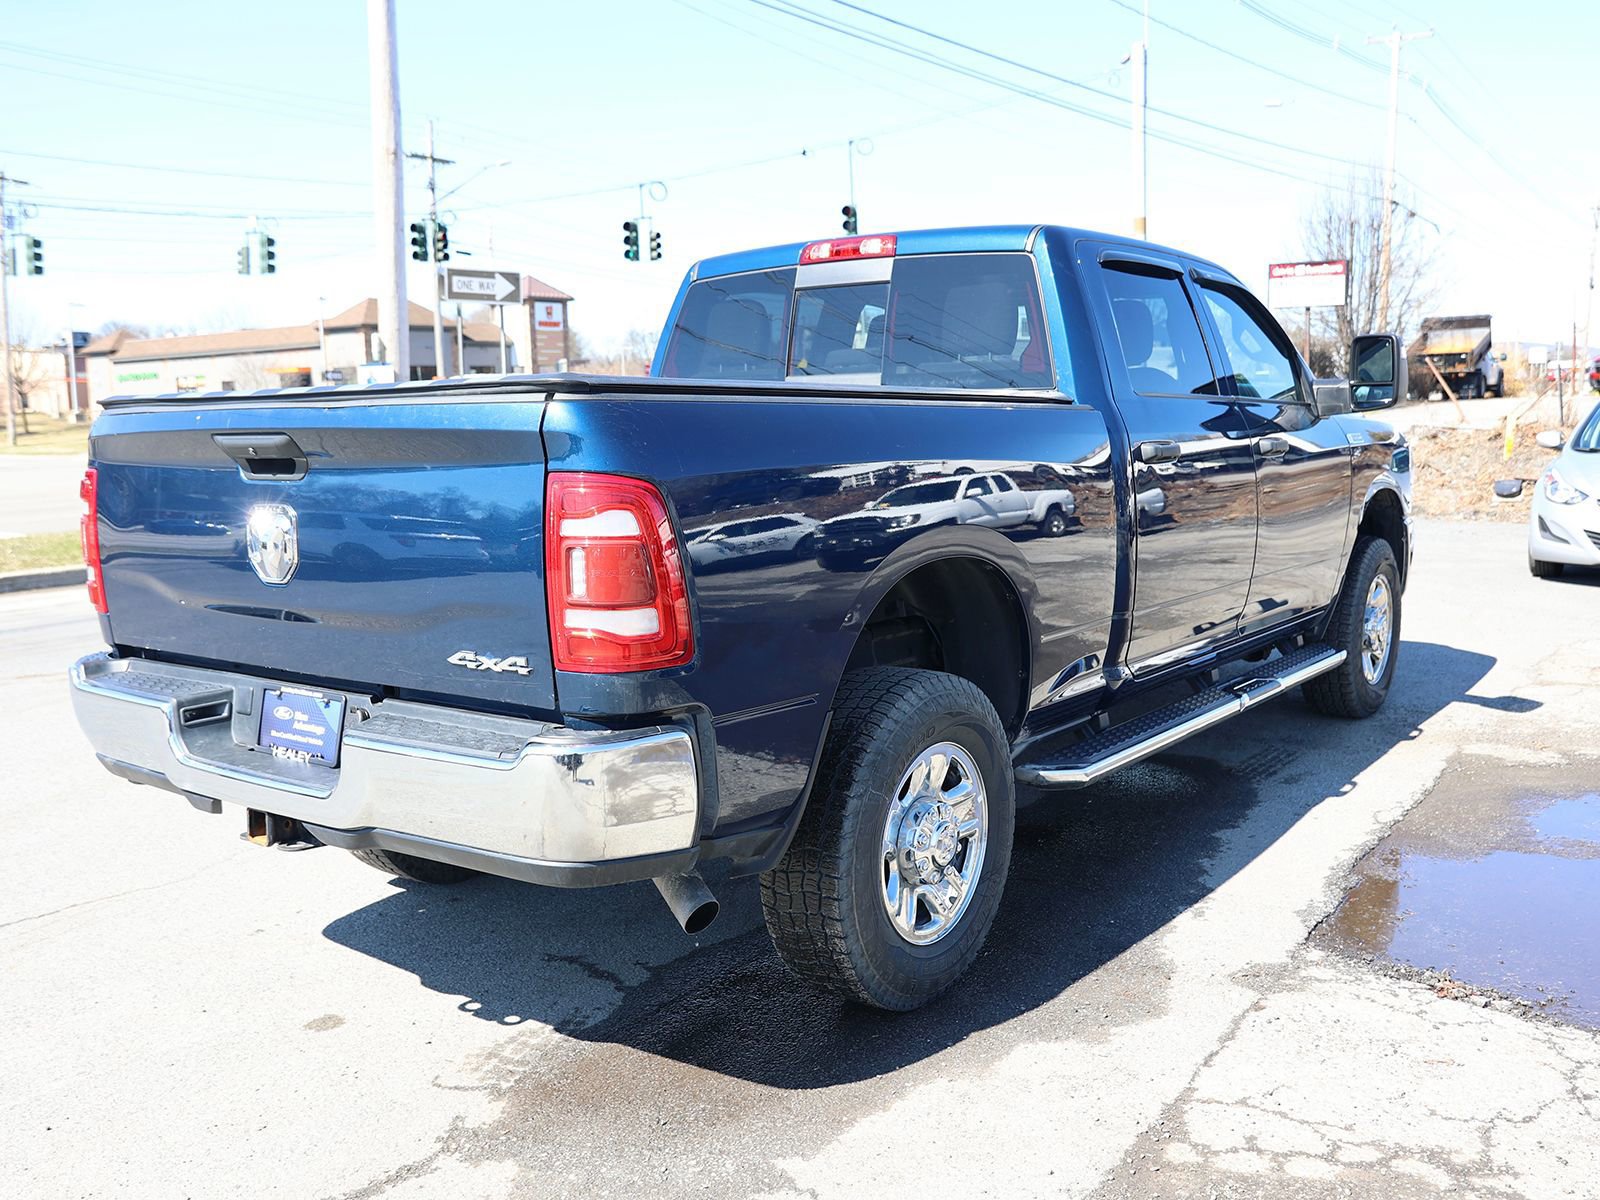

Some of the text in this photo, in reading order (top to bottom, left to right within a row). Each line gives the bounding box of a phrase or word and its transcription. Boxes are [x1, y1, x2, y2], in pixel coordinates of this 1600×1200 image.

[456, 279, 496, 292] ONE WAY
[272, 745, 312, 765] HEALEY
